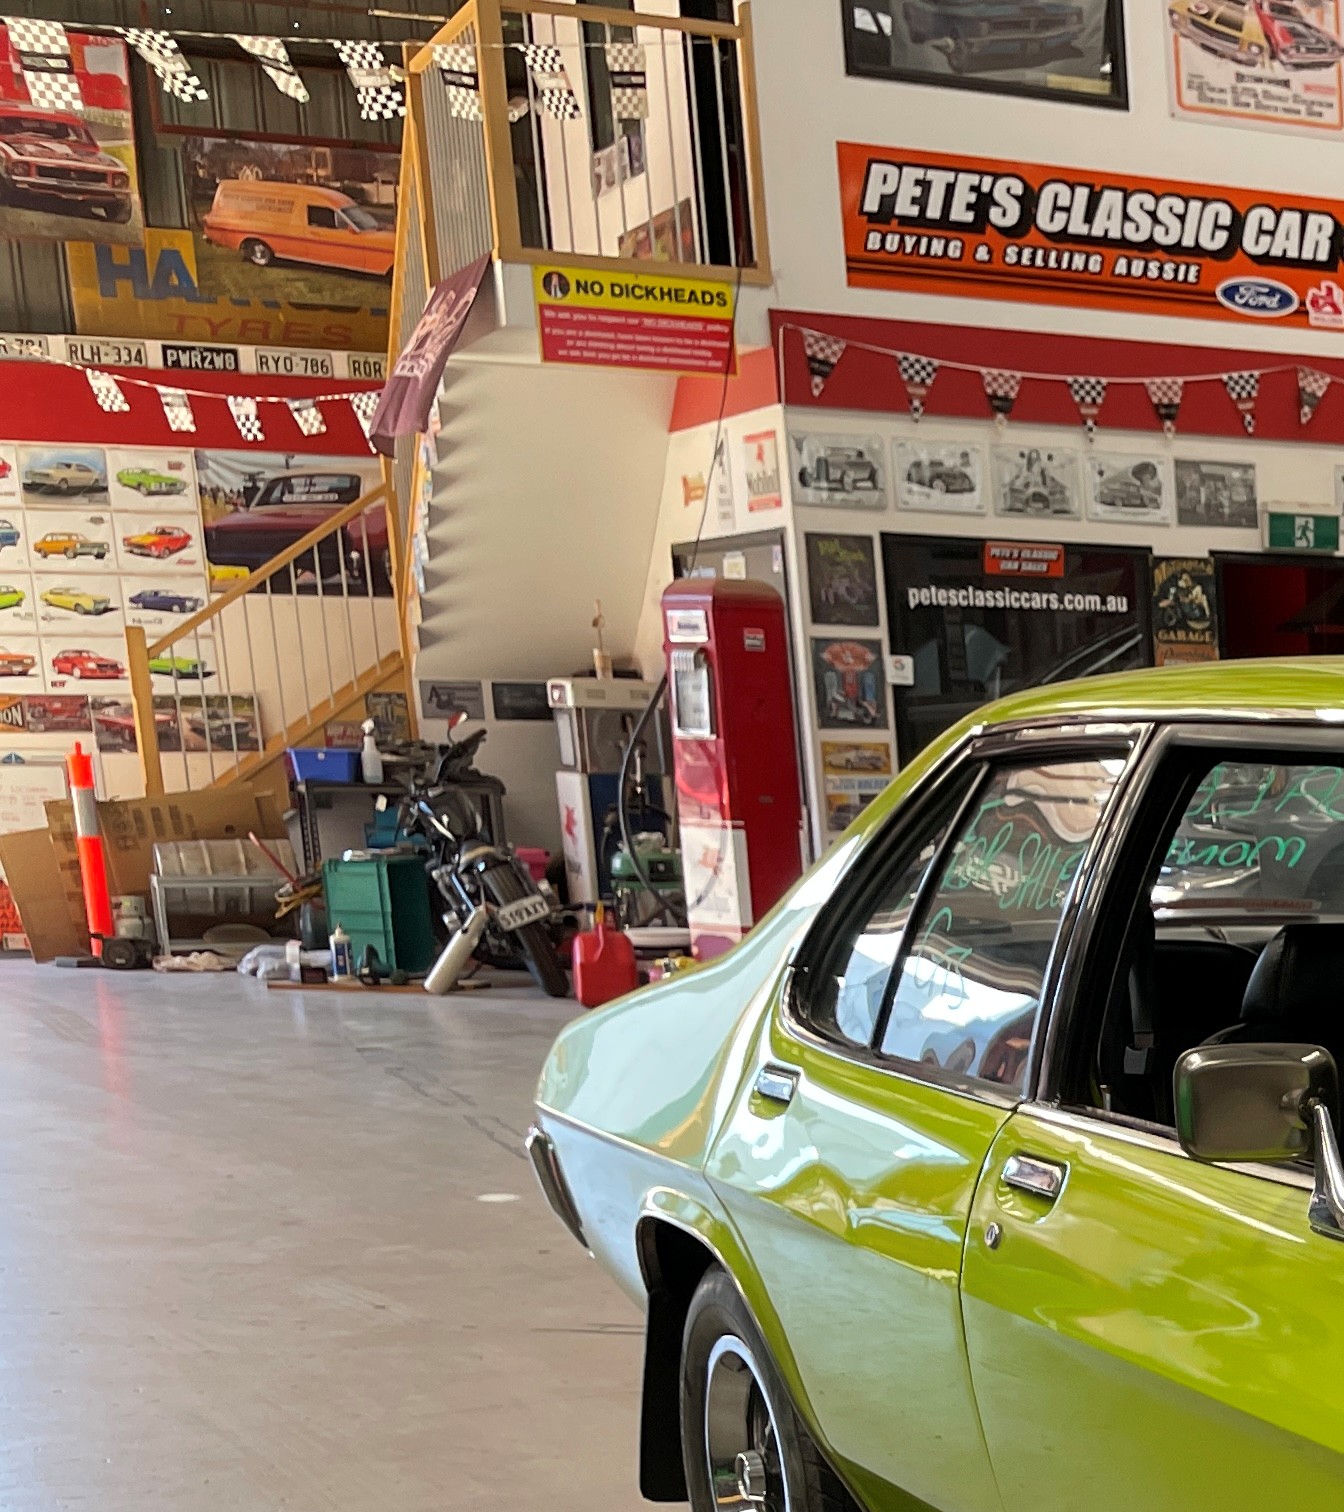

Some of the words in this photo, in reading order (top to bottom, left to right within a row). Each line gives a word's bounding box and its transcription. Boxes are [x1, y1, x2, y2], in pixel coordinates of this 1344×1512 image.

[863, 162, 1024, 229] PETE'S
[1035, 182, 1233, 251] CLASSIC
[1241, 206, 1337, 264] CAR
[866, 230, 963, 259] BUYING
[974, 244, 992, 263] &
[1004, 245, 1103, 274] SELLING
[1114, 256, 1201, 284] AUSSIE
[575, 279, 604, 297] NO
[610, 283, 728, 308] DICKHEADS
[1234, 283, 1283, 309] Ford
[167, 313, 351, 346] TYRES
[906, 584, 1129, 614] petesclassiccars.com.au
[1158, 629, 1213, 642] GARAGE
